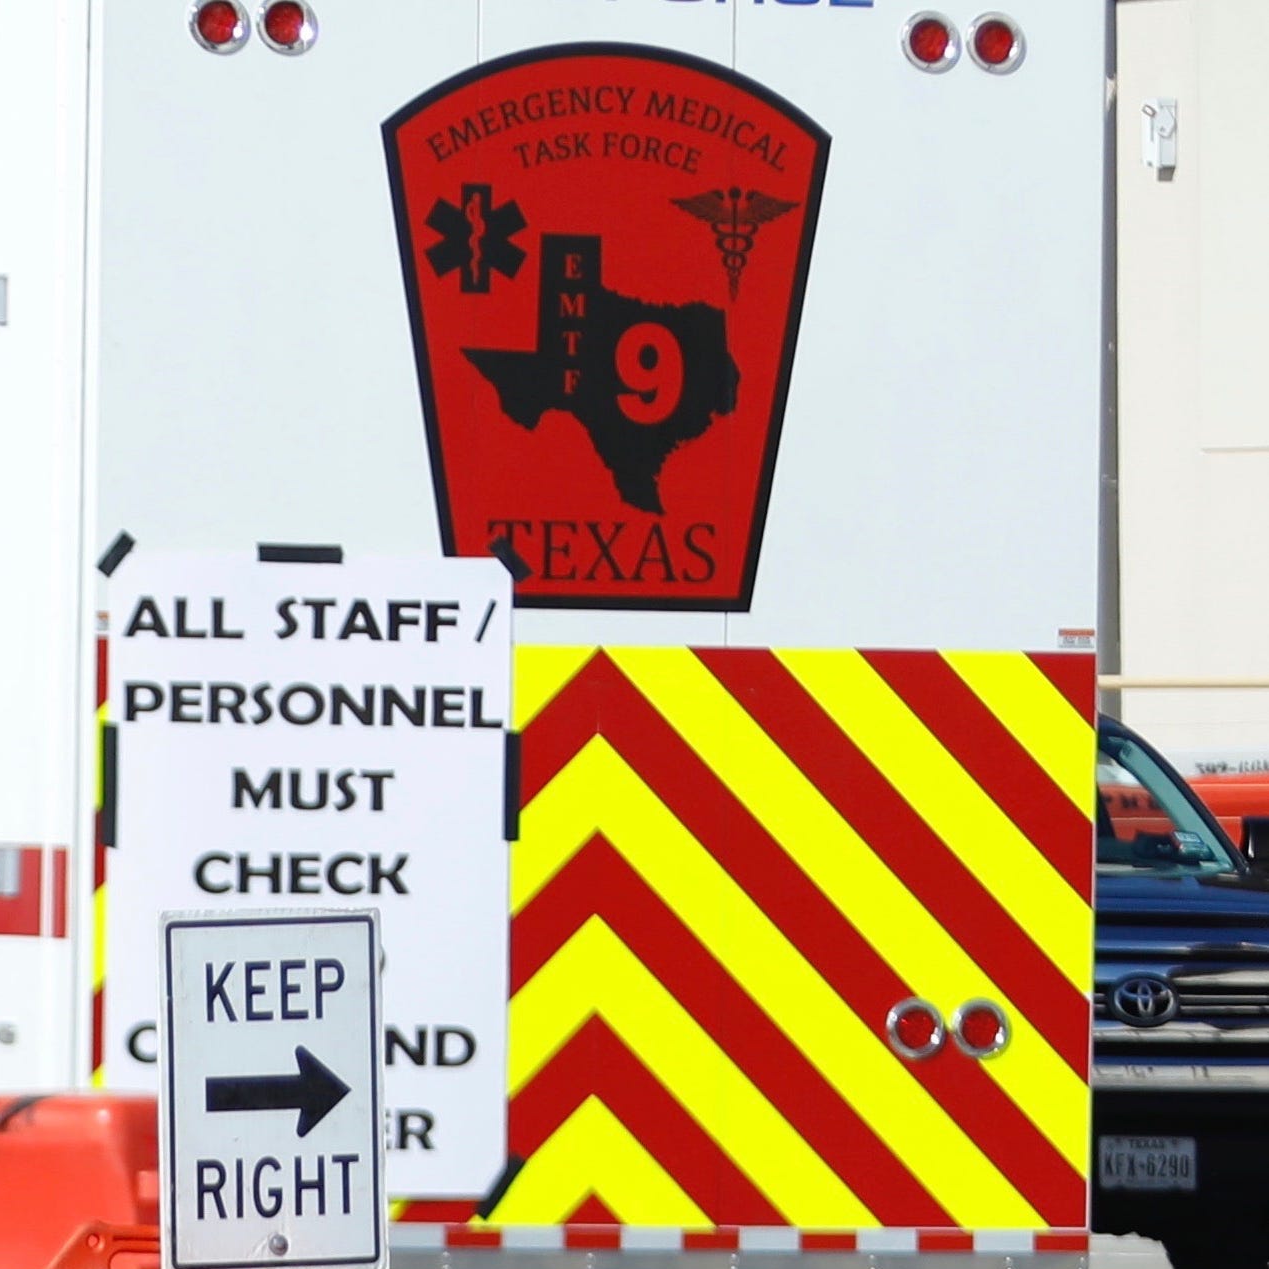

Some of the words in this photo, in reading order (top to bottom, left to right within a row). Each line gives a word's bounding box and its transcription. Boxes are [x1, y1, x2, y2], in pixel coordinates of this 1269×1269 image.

[425, 85, 636, 163] EMERGENCY
[643, 90, 789, 173] MEDICAL
[513, 132, 592, 169] TASK
[602, 132, 703, 175] FORCE
[614, 322, 685, 425] 9
[123, 597, 245, 640] ALL
[123, 681, 503, 728] PERSONNEL
[231, 768, 395, 812] MUST
[192, 851, 410, 896] CHECK
[204, 957, 346, 1023] KEEP
[195, 1153, 360, 1220] RIGHT
